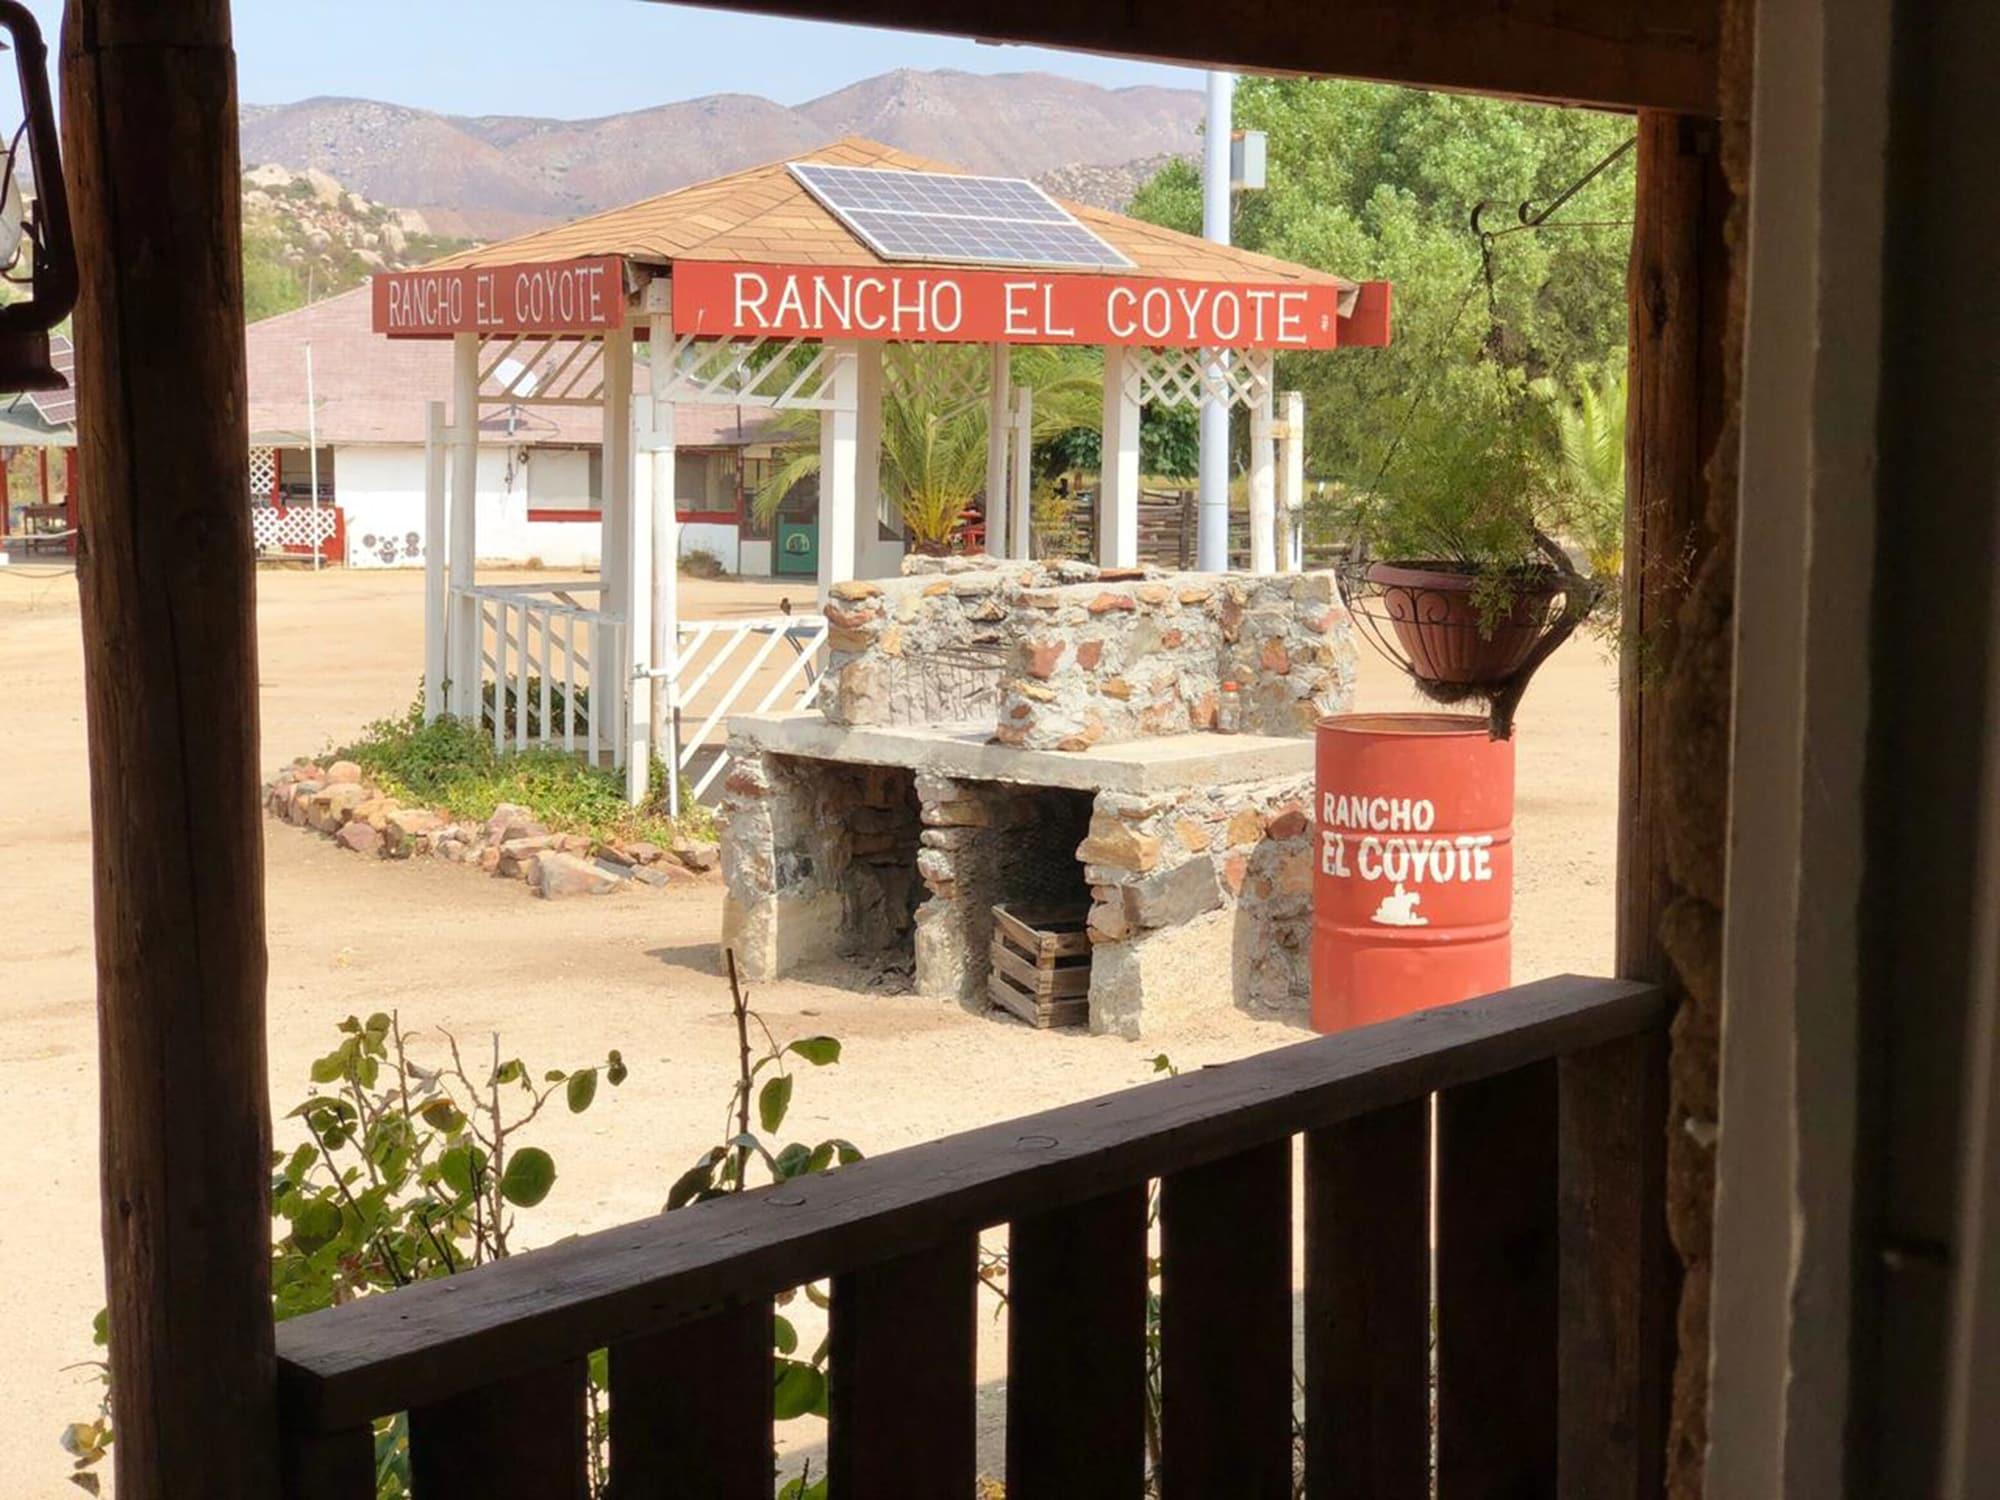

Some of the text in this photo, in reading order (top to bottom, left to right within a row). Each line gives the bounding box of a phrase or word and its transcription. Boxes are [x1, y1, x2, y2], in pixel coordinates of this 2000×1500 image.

[389, 266, 605, 327] RANCHO EL COYOTE
[733, 272, 1308, 344] RANCHO EL COYOTE
[1323, 792, 1435, 832] RANCHO
[1321, 831, 1494, 883] EL COYOTE
